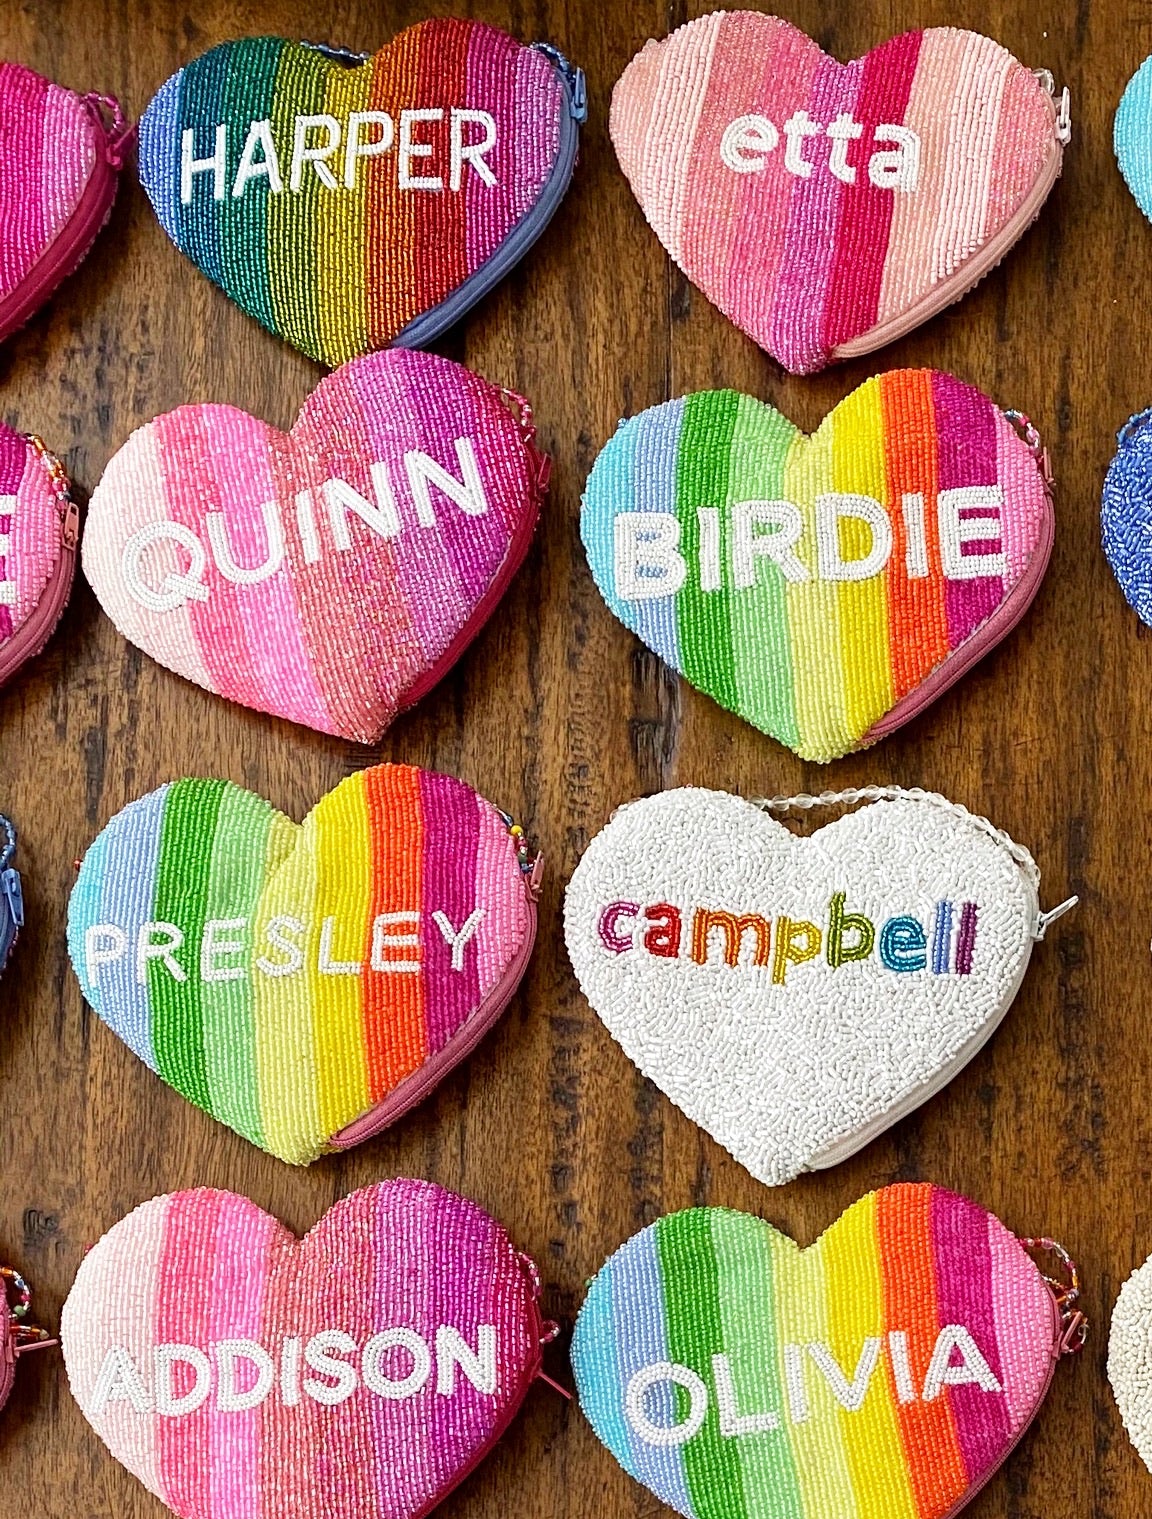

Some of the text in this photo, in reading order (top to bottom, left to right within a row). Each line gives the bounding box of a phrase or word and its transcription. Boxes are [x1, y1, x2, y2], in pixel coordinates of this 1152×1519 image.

[179, 108, 499, 205] HARPER
[720, 111, 921, 193] etta
[121, 436, 489, 612] QUINN
[613, 485, 1008, 600] BIRDIE
[83, 908, 487, 989] PRESLEY
[598, 891, 978, 985] campbell
[89, 1323, 499, 1417] ADDISON
[624, 1324, 1002, 1446] OLIVIA
